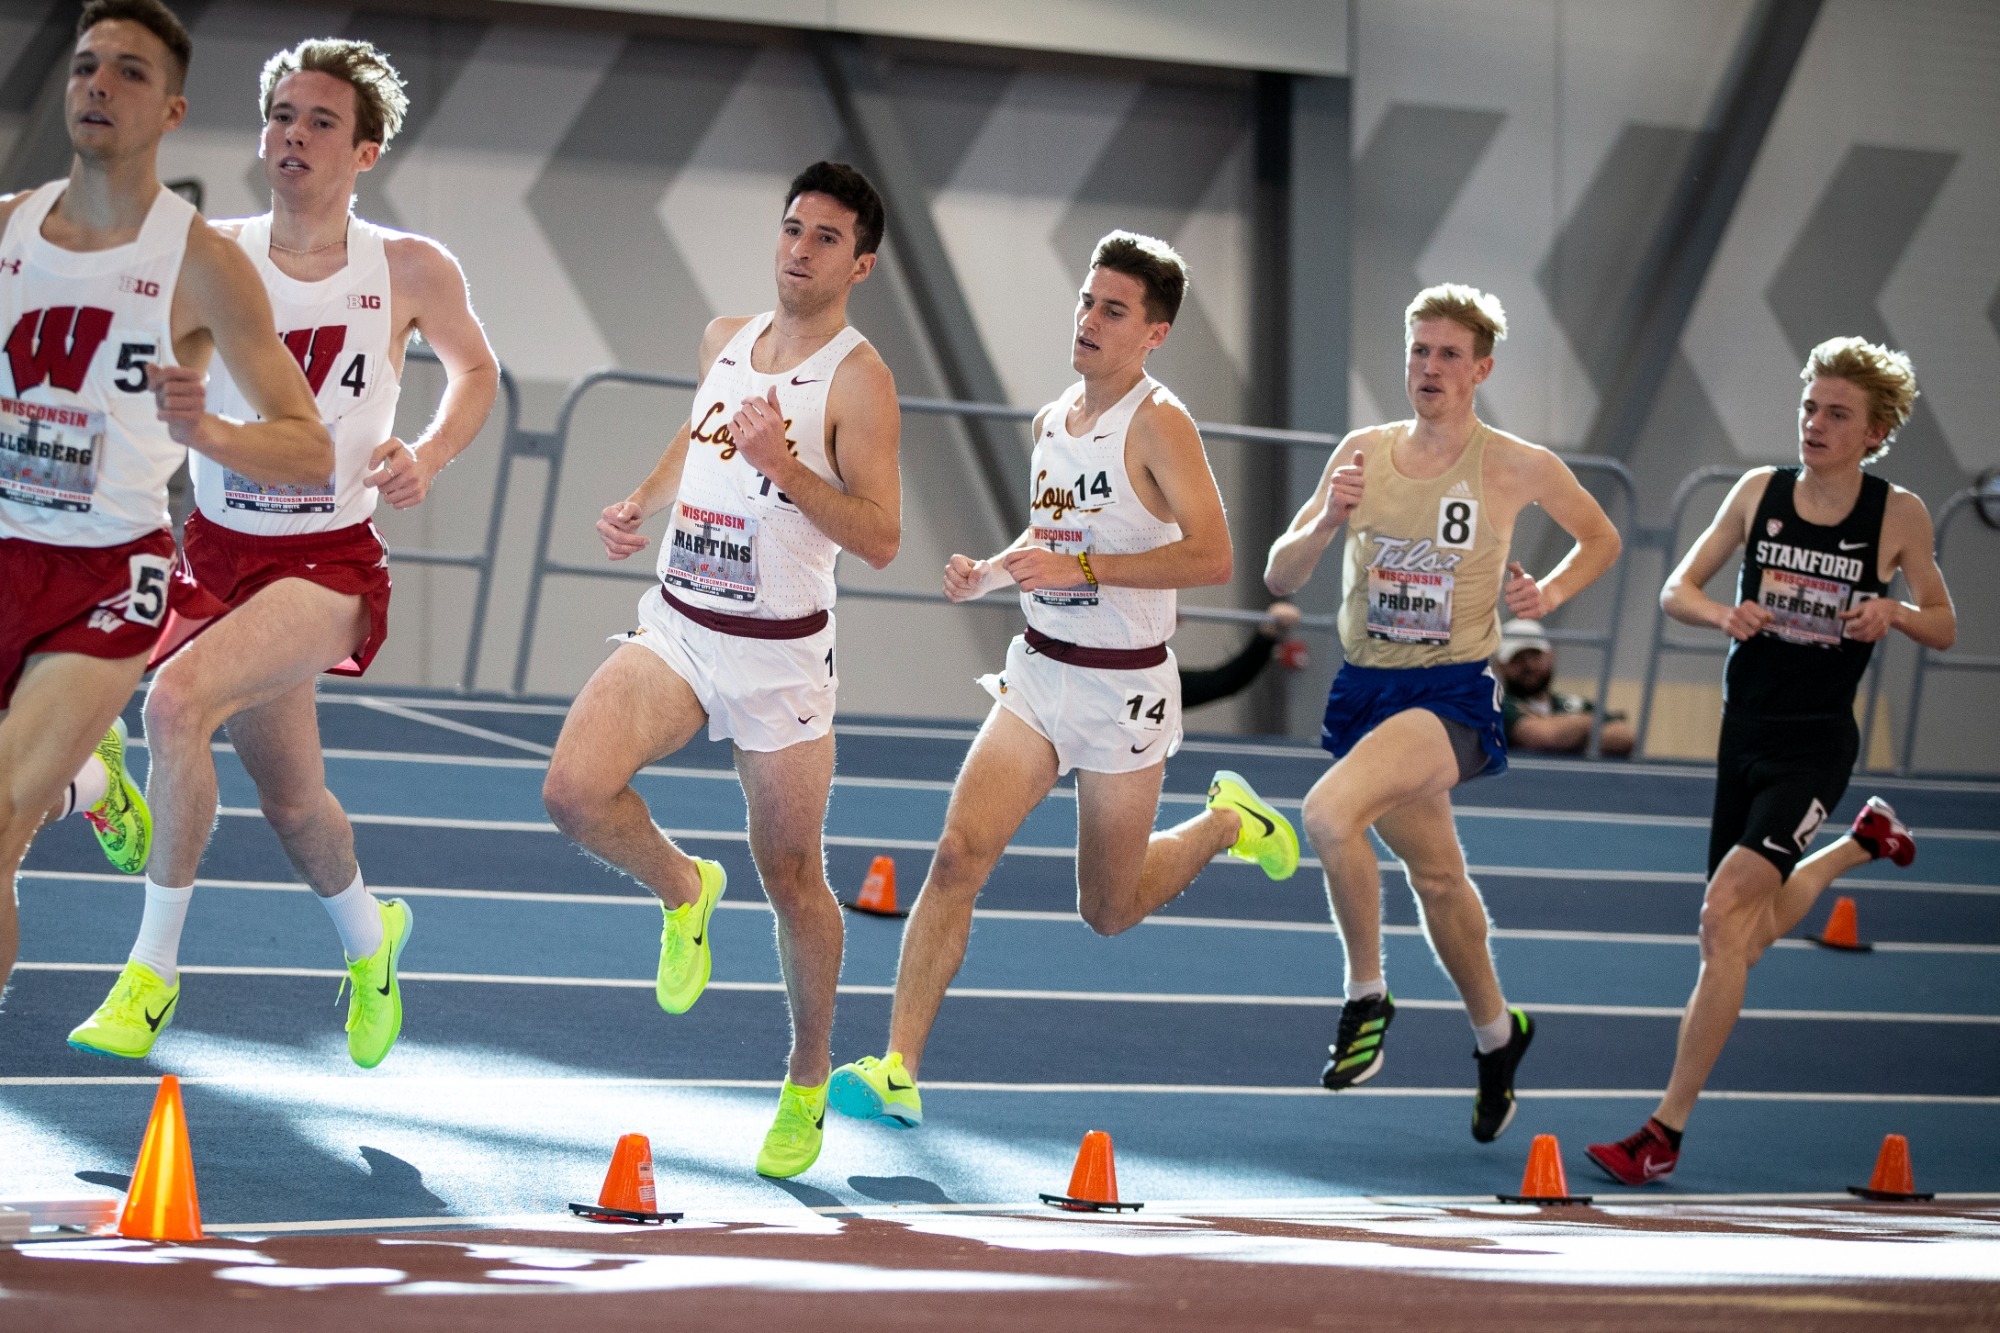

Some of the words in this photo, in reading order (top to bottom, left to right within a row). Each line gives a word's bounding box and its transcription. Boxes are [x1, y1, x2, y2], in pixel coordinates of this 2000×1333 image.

[3, 306, 115, 397] W
[114, 343, 155, 393] 5
[341, 354, 366, 397] 4
[1, 399, 88, 428] WISCONSIN
[1075, 471, 1112, 501] 14
[682, 504, 746, 530] WISCONSIN
[1442, 502, 1471, 545] 8
[673, 529, 752, 563] MARTINS
[1034, 528, 1083, 542] WISCONSIN
[1366, 535, 1463, 572] Tulsa
[1755, 540, 1864, 583] STANFORD
[134, 566, 163, 619] 5
[699, 577, 728, 588] WISCONSIN
[1378, 569, 1442, 586] WISCONSIN
[1773, 571, 1840, 593] WISCONSIN
[1378, 592, 1436, 613] PROPP
[1765, 592, 1837, 620] BERGEN
[1126, 694, 1166, 724] 14
